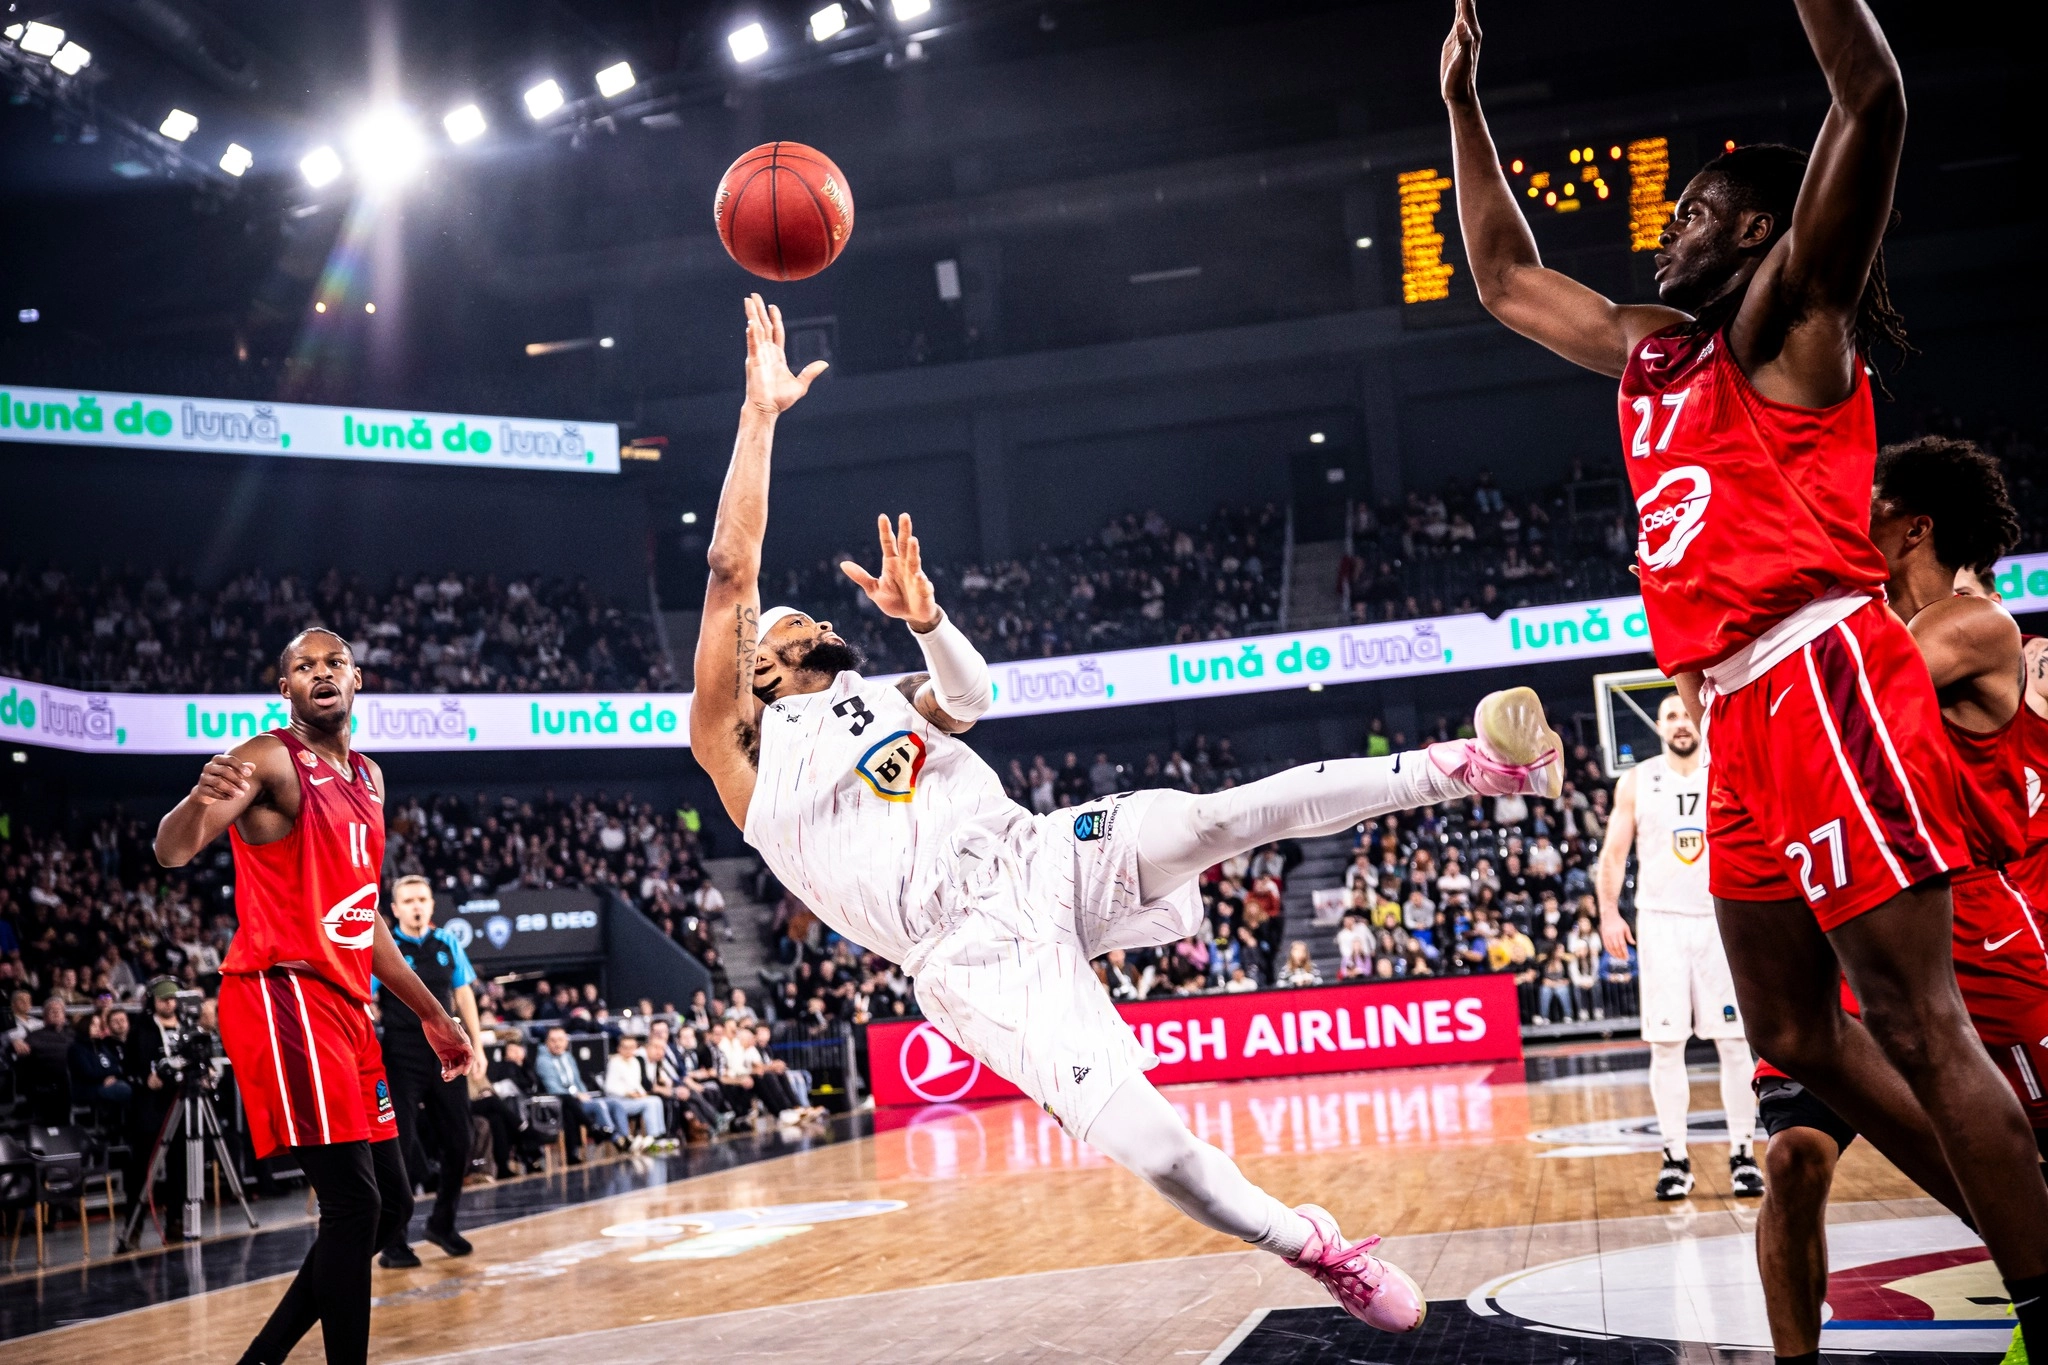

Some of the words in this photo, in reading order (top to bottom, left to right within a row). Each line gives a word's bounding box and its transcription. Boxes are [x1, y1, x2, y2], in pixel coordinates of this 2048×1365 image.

[0, 391, 104, 432] lună
[114, 400, 173, 438] de
[181, 401, 291, 449] lună,
[343, 414, 433, 451] lună
[441, 421, 493, 455] de
[500, 421, 595, 465] lună,
[1632, 387, 1691, 458] 27
[1340, 622, 1453, 670] lună,
[1510, 607, 1611, 650] lună
[1008, 659, 1115, 703] lună,
[1169, 644, 1264, 686] lună
[1275, 640, 1331, 675] de
[0, 687, 36, 728] de
[40, 690, 126, 745] lună,
[368, 700, 477, 742] lună,
[531, 701, 619, 735] lună
[629, 702, 677, 734] de
[832, 695, 875, 737] 3
[1676, 792, 1701, 816] 17
[349, 821, 370, 868] 11
[1679, 836, 1699, 848] BT
[1784, 818, 1851, 903] 27
[515, 913, 548, 931] 28
[1242, 998, 1487, 1058] AIRLINES
